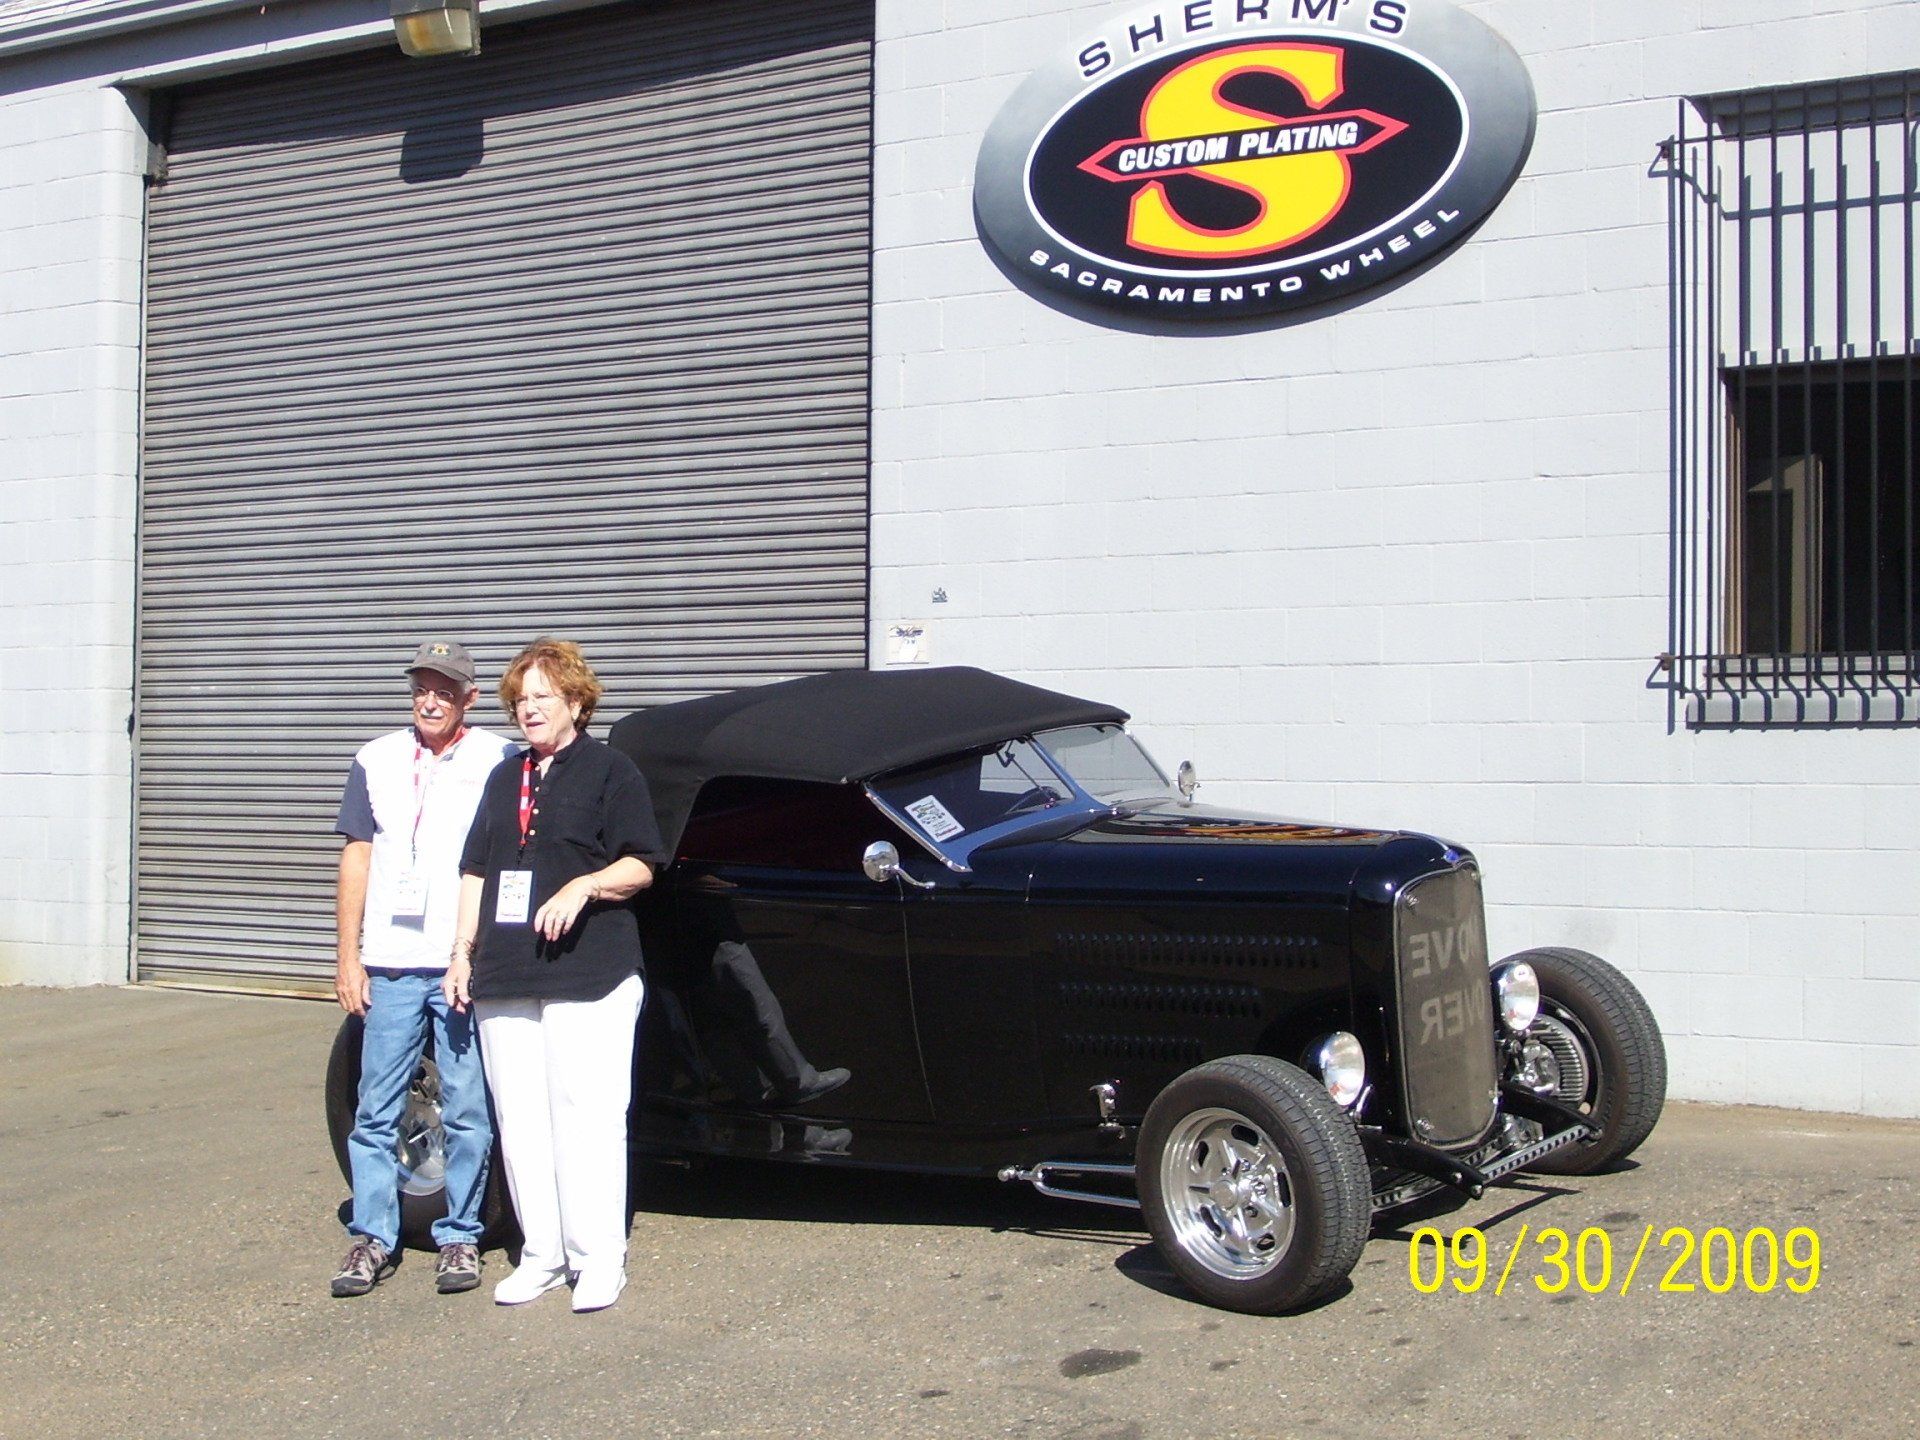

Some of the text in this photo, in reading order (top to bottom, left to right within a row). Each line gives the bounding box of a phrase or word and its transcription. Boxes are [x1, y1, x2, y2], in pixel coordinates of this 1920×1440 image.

[1077, 0, 1407, 78] SHERM'S
[1118, 122, 1358, 172] CUSTOM PLATING
[1029, 207, 1460, 302] SACRAMENTO WHEEL
